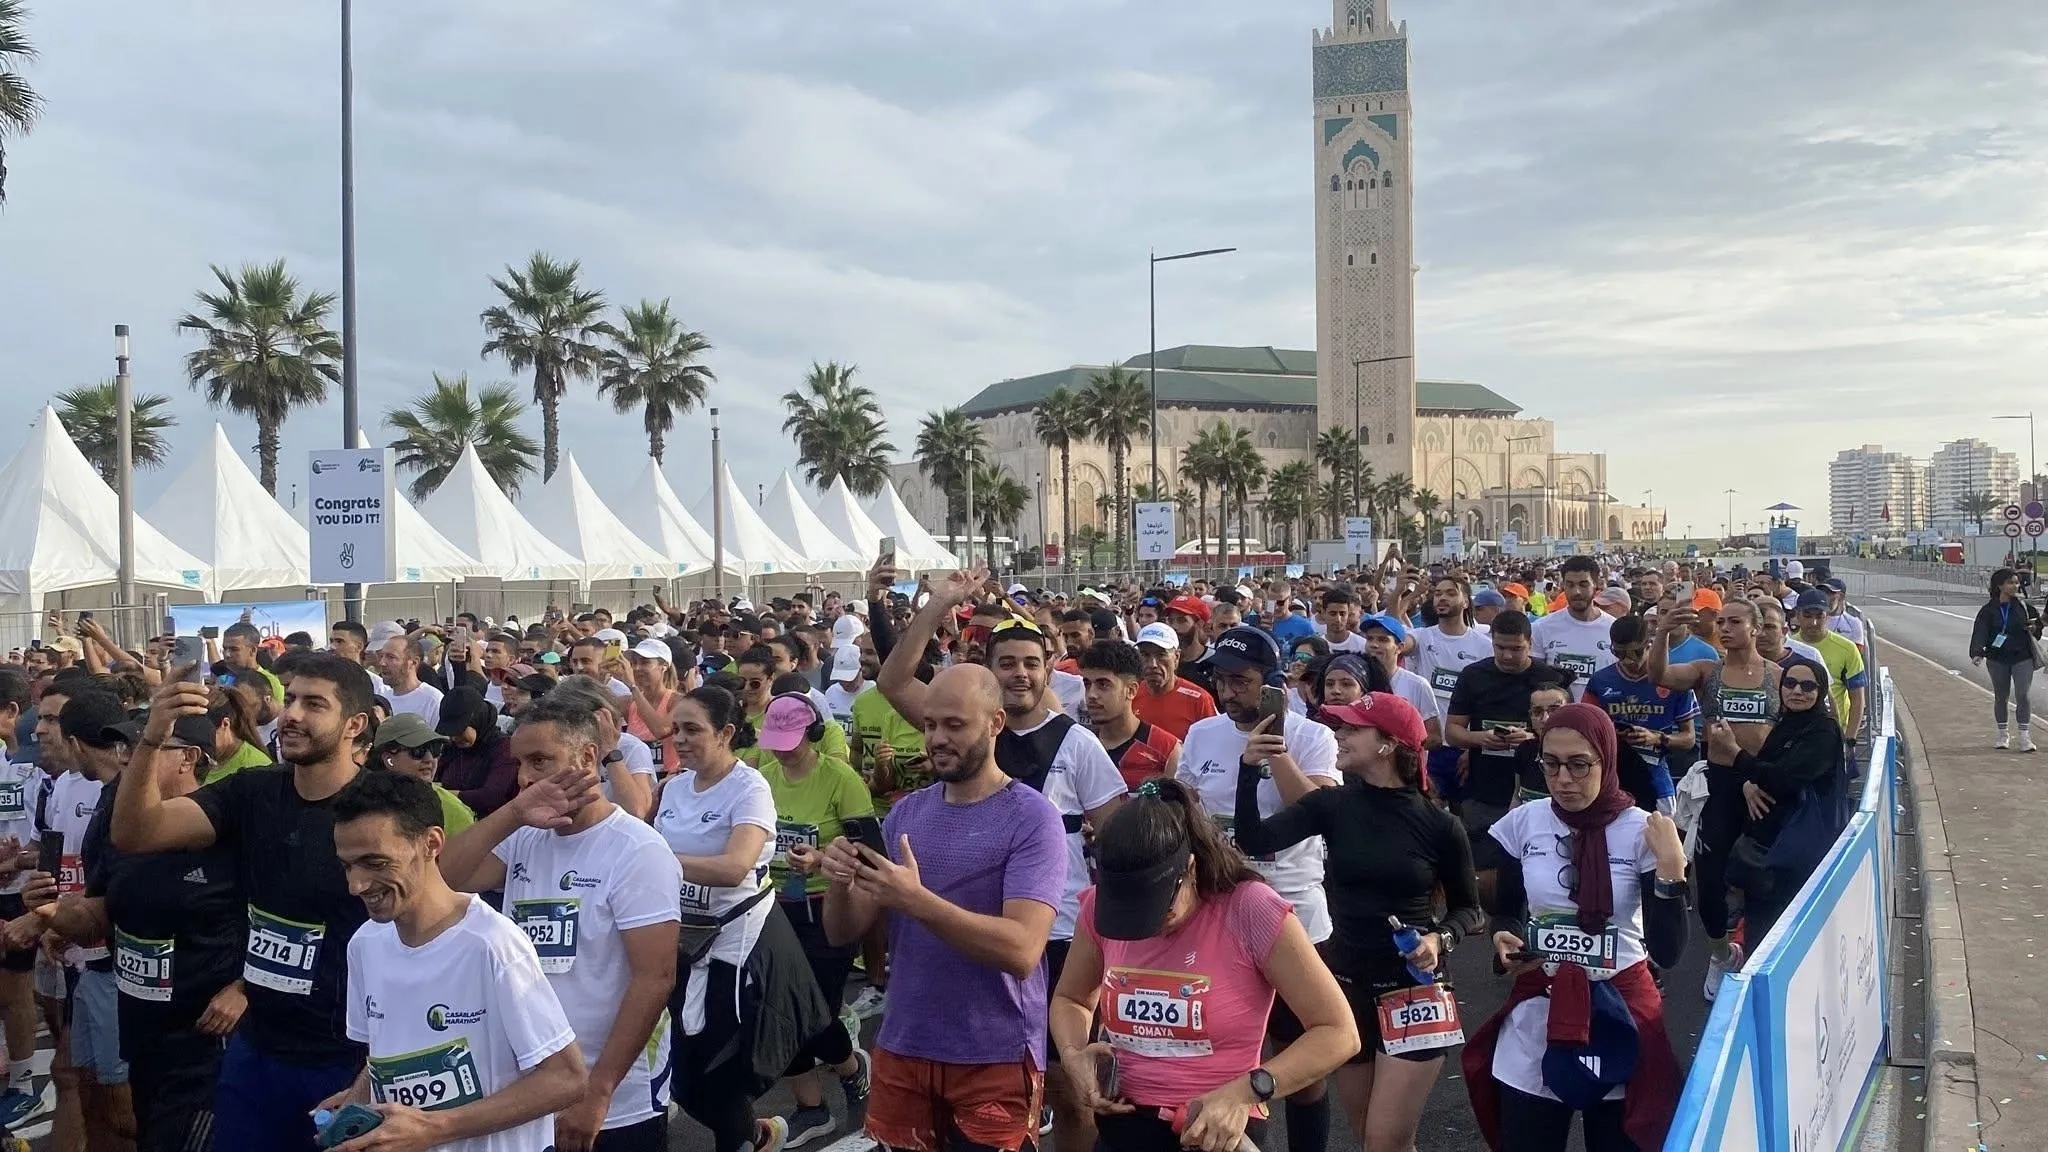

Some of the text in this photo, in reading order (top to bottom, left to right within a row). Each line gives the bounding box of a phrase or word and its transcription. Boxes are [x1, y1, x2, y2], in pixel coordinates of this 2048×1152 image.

[315, 497, 381, 513] Congrats
[316, 513, 380, 525] YOU DID IT!
[2029, 524, 2041, 533] 60
[258, 621, 280, 638] ali
[1608, 701, 1665, 716] Diwan
[1726, 702, 1754, 712] 7369
[0, 795, 12, 805] 35
[522, 924, 554, 944] 952
[251, 936, 292, 962] 2714
[1544, 933, 1594, 953] 6259
[120, 953, 149, 975] 6271
[1548, 952, 1589, 965] YOUSSRA
[445, 1008, 487, 1018] CASABLANCA
[1125, 1000, 1179, 1023] 4236
[1400, 1005, 1440, 1025] 5821
[445, 1017, 481, 1025] MARATHON
[1132, 1025, 1174, 1038] SOMAYA
[389, 1079, 446, 1107] 7899
